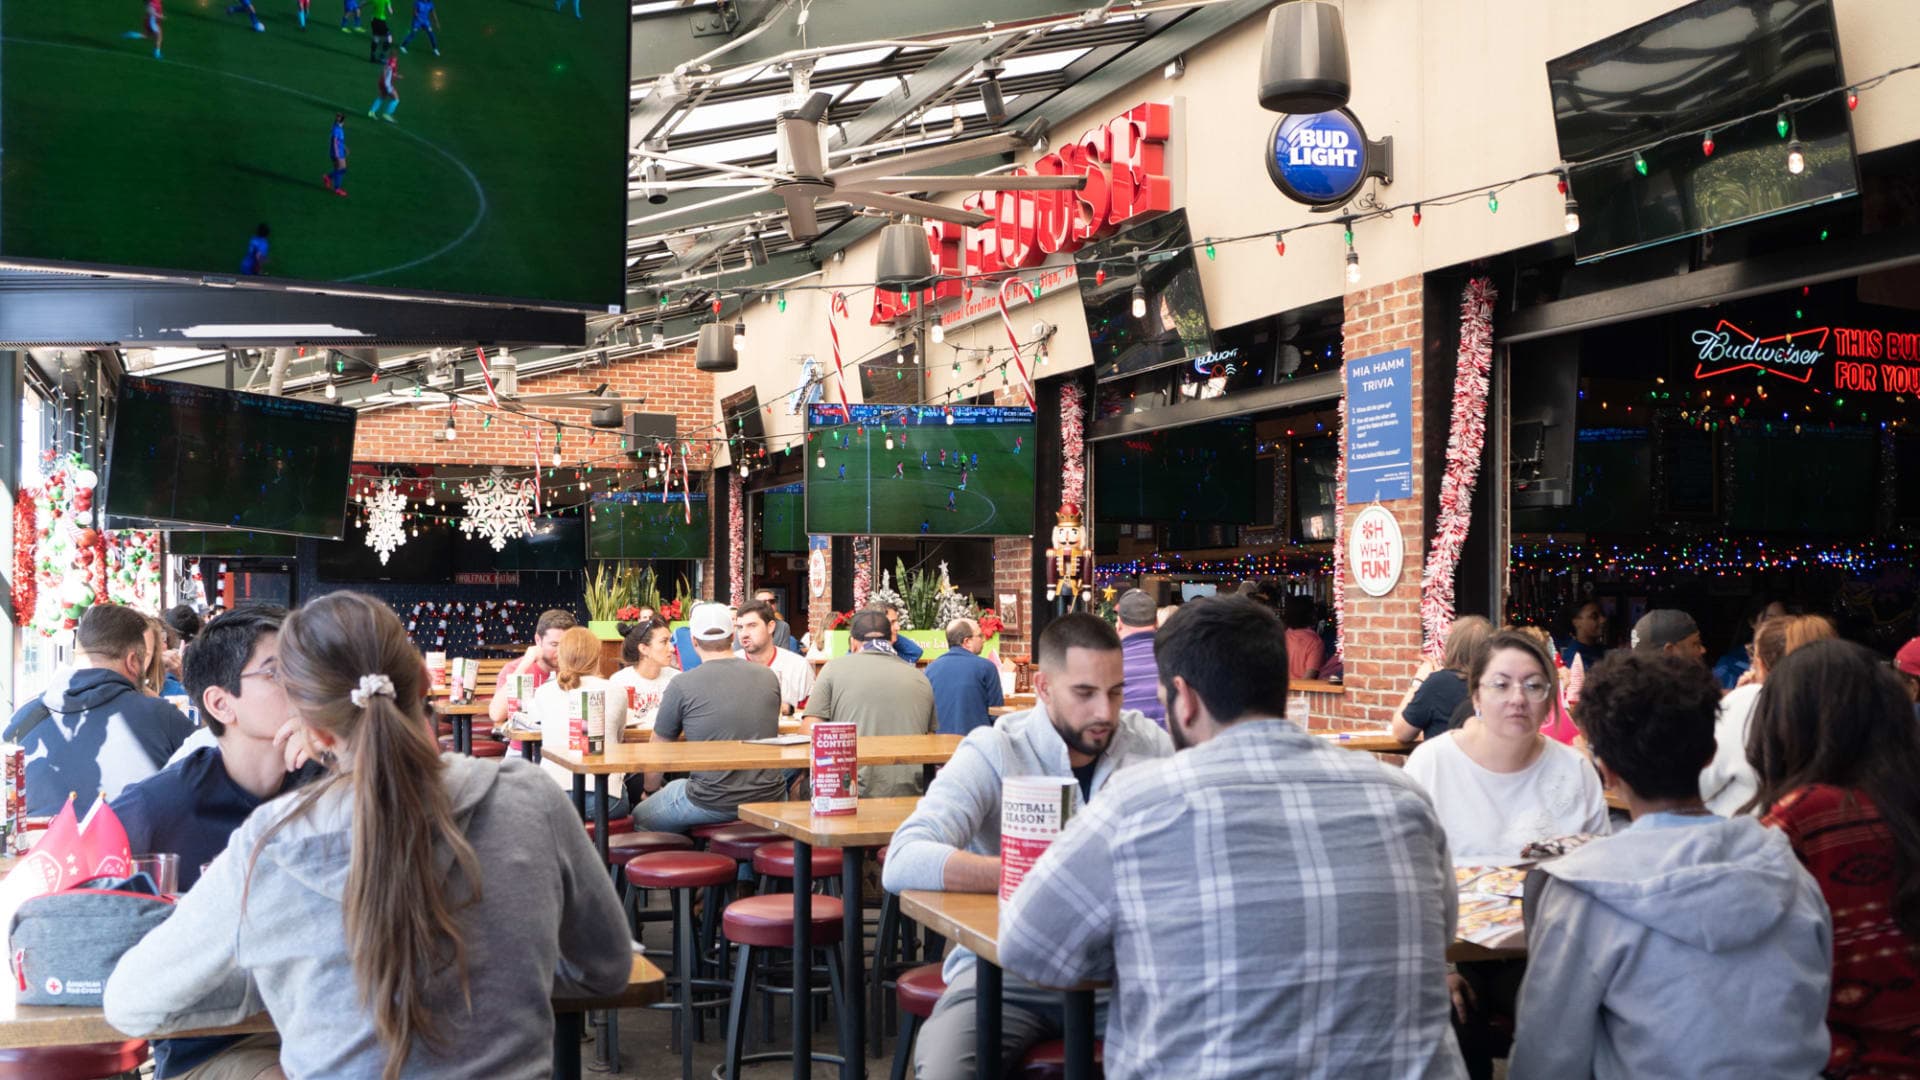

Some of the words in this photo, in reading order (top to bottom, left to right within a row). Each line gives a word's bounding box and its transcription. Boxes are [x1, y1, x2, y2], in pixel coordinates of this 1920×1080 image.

[1289, 129, 1349, 148] BUD
[1288, 147, 1358, 167] LIGHT
[963, 102, 1170, 275] HOUSE
[1691, 328, 1824, 366] Budweiser
[1833, 328, 1882, 359] THIS
[1352, 365, 1371, 378] MIA
[1373, 358, 1404, 373] HAMM
[1834, 362, 1877, 392] FOR
[1362, 377, 1394, 392] TRIVIA
[1360, 541, 1390, 559] WHAT
[1361, 560, 1391, 579] FUN!
